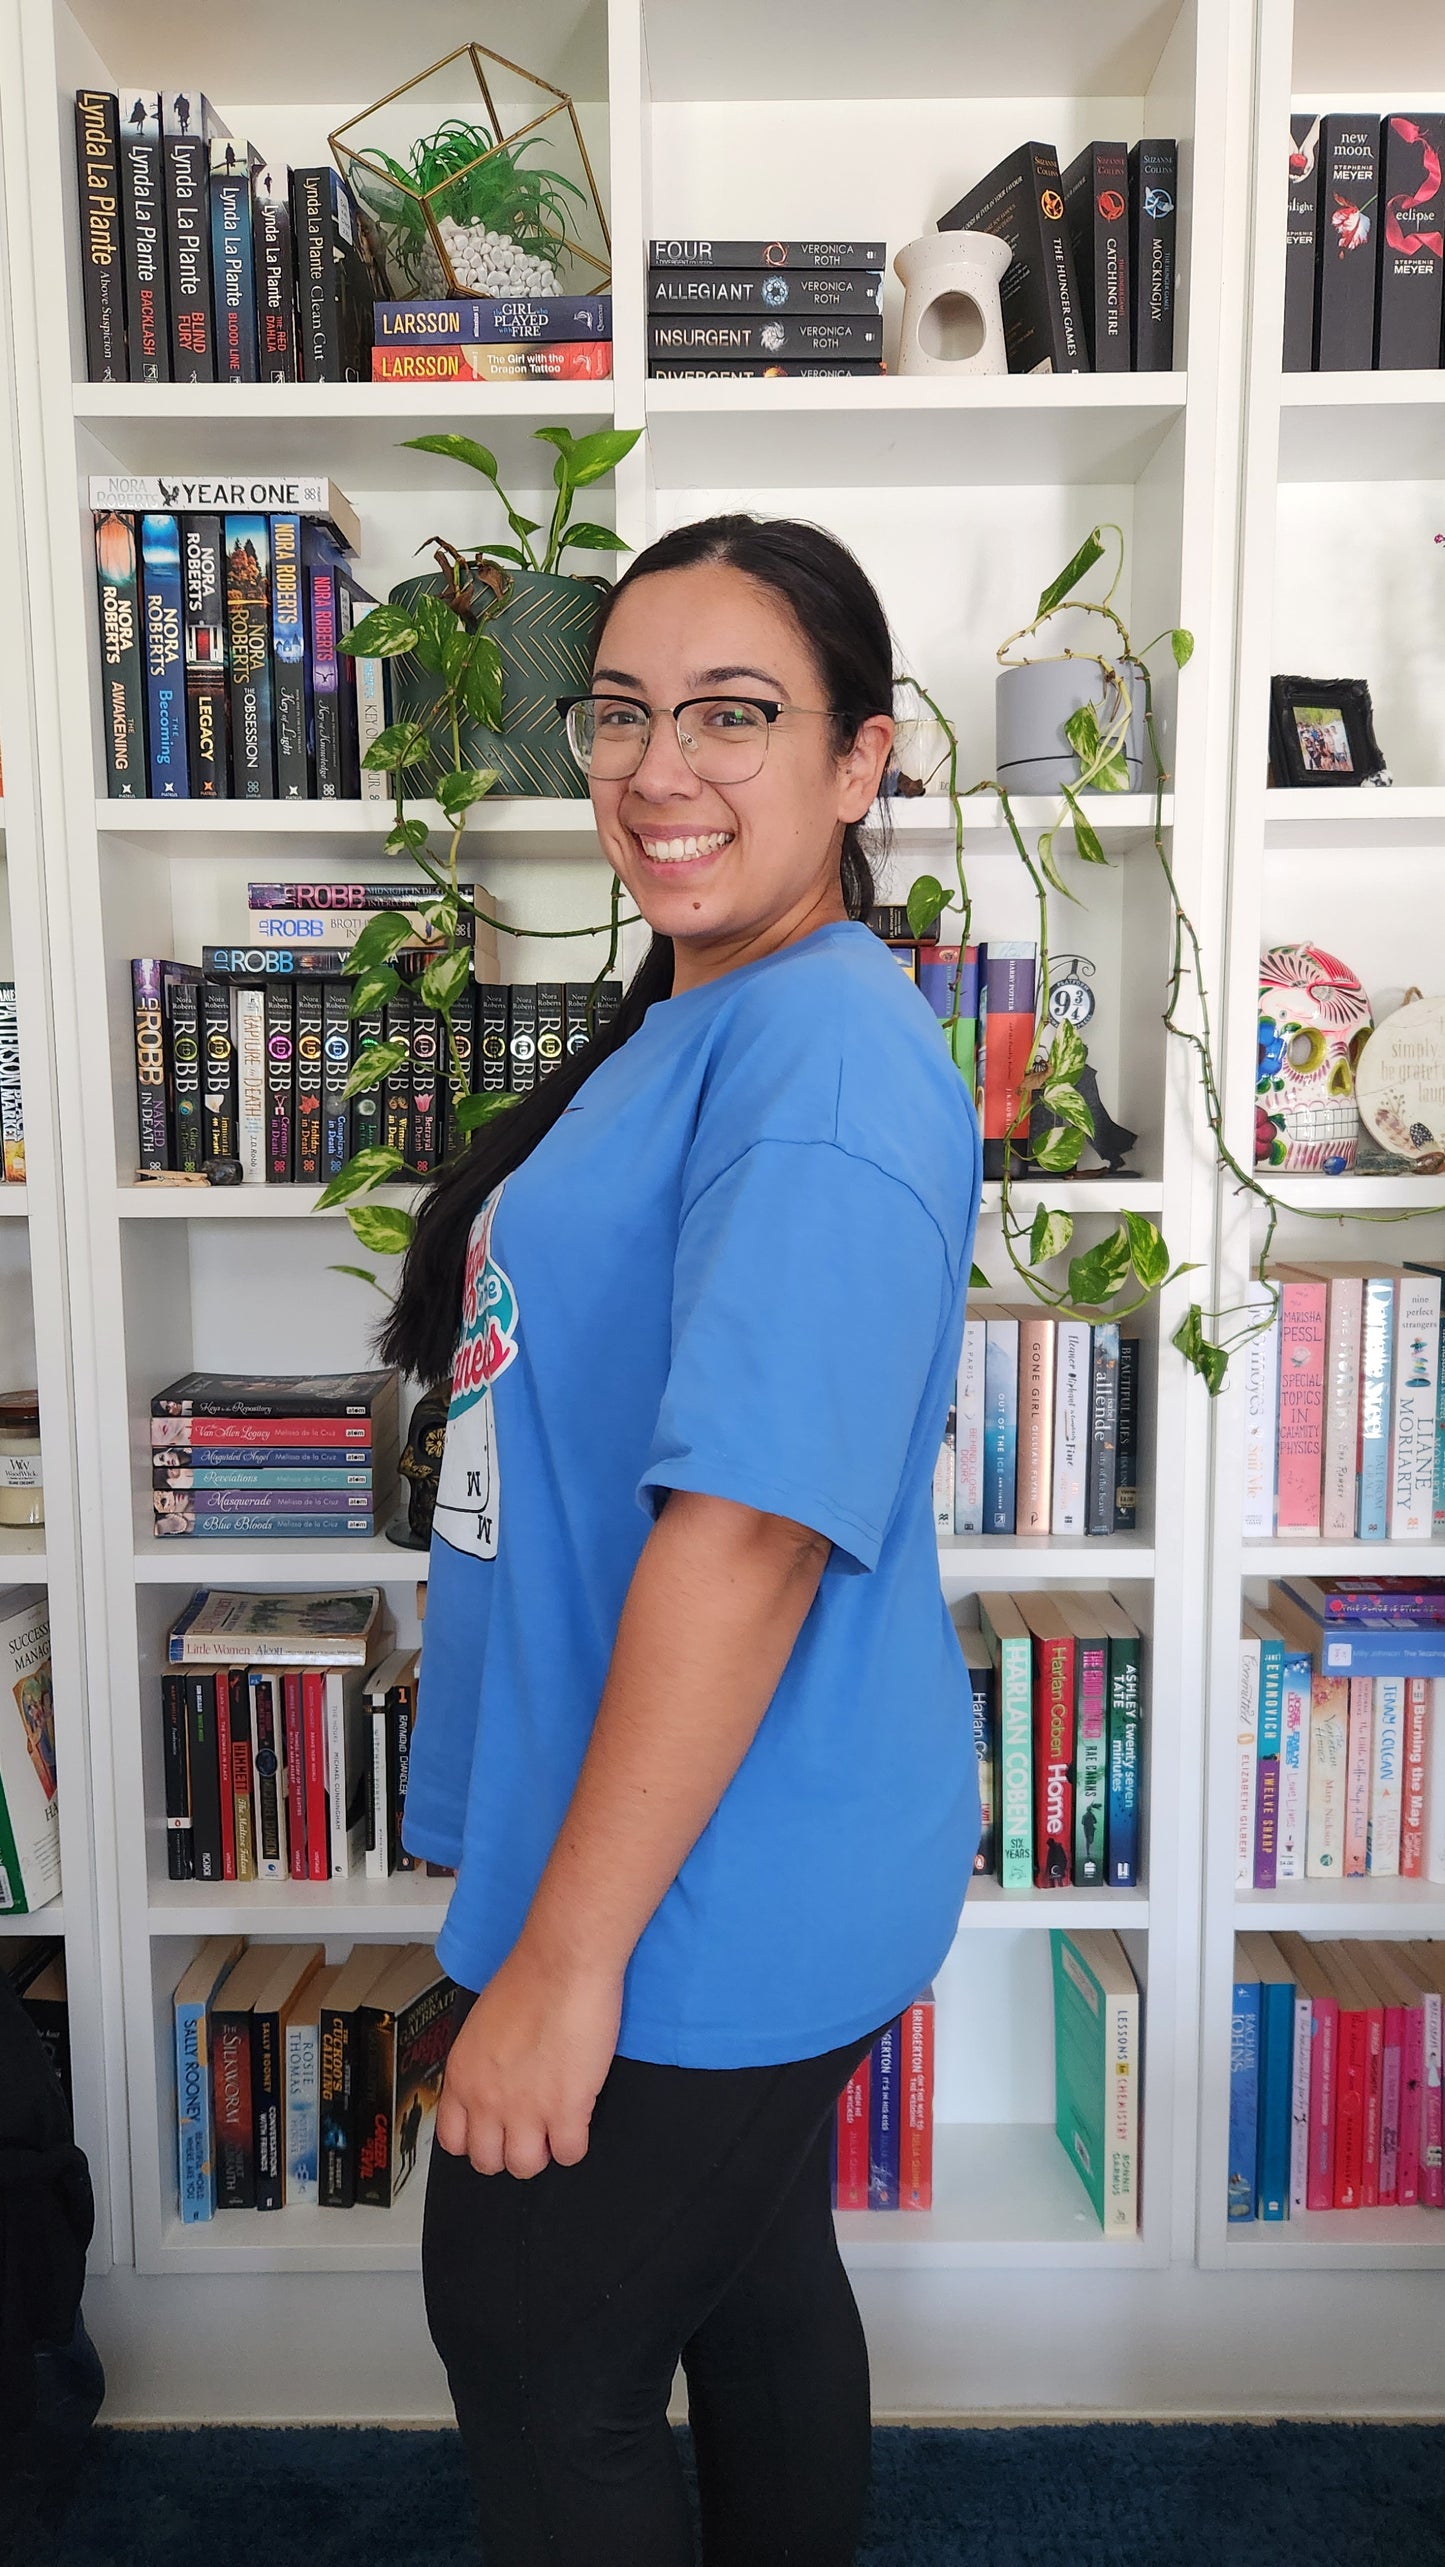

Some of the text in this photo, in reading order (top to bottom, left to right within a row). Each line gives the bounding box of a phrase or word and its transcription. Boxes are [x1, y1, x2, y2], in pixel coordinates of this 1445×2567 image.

[1334, 144, 1374, 159] moon
[1342, 133, 1368, 144] new
[79, 92, 117, 266] Lynda La Plante
[1333, 171, 1373, 180] MEYER
[128, 146, 156, 282] Lynda La Plante
[171, 145, 199, 296] Lynda La Plante
[303, 176, 323, 280] Lynda La Plante
[1396, 210, 1435, 231] eclipse
[220, 187, 243, 307] Lynda La Plante
[261, 206, 281, 309] Lynda La Plante
[655, 242, 712, 260] FOUR
[801, 245, 854, 255] VERONICA
[815, 255, 840, 265] ROTH
[801, 282, 853, 292] VERONICA
[1107, 238, 1118, 336] CATCHING FIRE
[1152, 238, 1162, 322] MOCKINGJAY
[1394, 265, 1433, 274] MEYER
[99, 271, 111, 358] Above Suspicion
[502, 304, 536, 316] GIRL
[655, 284, 753, 301] ALLEGIANT
[814, 294, 839, 304] ROTH
[1053, 238, 1077, 356] THE HUNGER GAMES
[140, 290, 155, 355] BACKLASH
[178, 315, 191, 350] FURY
[191, 312, 205, 353] BLIND
[228, 312, 240, 370] BLOOD LINE
[266, 316, 276, 352] DAHLIA
[276, 331, 286, 352] RED
[310, 285, 326, 360] Clean Cut
[383, 312, 460, 335] LARSSON
[494, 315, 549, 327] PLAYED
[512, 326, 541, 336] FIRE
[655, 330, 752, 347] INSURGENT
[800, 327, 852, 336] VERONICA
[488, 354, 564, 364] The Girl with the
[813, 339, 838, 348] ROTH
[382, 356, 459, 377] LARSSON
[491, 364, 560, 374] Dragon Tattoo
[183, 486, 299, 504] YEAR ONE
[186, 533, 202, 612] ROBERTS
[201, 548, 215, 598] NORA
[274, 523, 298, 625] NORA ROBERTS
[103, 586, 120, 665] ROBERTS
[117, 599, 133, 651] NORA
[148, 595, 165, 676] ROBERTS
[163, 608, 178, 664] NORA
[314, 577, 333, 661] NORA ROBERTS
[230, 609, 249, 685] ROBERTS
[249, 624, 265, 671] NORA
[111, 681, 129, 771] AWAKENING
[157, 690, 173, 765] Becoming
[199, 696, 214, 762] LEGACY
[244, 695, 259, 769] OBSESSION
[297, 886, 365, 908] ROBB
[270, 920, 324, 936] ROBB
[230, 951, 294, 973] ROBB
[1054, 990, 1070, 1016] 9
[136, 1011, 163, 1085] ROBB
[1392, 1038, 1439, 1062] simply
[142, 1092, 154, 1153] IN DEATH
[153, 1101, 164, 1148] NAKED
[1283, 1311, 1322, 1322] MARISHA
[1406, 1308, 1434, 1318] perfect
[1412, 1295, 1429, 1304] nine
[1283, 1326, 1322, 1342] PESSL
[1402, 1320, 1438, 1329] strangers
[1031, 1342, 1041, 1418] GONE GIRL
[1282, 1374, 1322, 1388] SPECIAL
[1282, 1391, 1321, 1406] TOPICS
[998, 1418, 1004, 1431] OF
[1094, 1371, 1112, 1441] allende
[1291, 1408, 1308, 1424] IN
[1279, 1441, 1320, 1455] PHYSICS
[1280, 1425, 1319, 1439] CALAMITY
[1416, 1417, 1434, 1490] LIANE
[1397, 1399, 1414, 1510] MORIARTY
[203, 1516, 273, 1531] Blue Bloods
[208, 1491, 272, 1512] Masquerade
[187, 1644, 250, 1656] Little Women
[1050, 1647, 1067, 1758] Harlan Coben
[1113, 1674, 1125, 1708] TATE
[1125, 1664, 1137, 1717] ASHLEY
[1264, 1665, 1279, 1739] EVANOVICH
[973, 1692, 986, 1739] Harlan
[1005, 1647, 1028, 1836] HARLAN COBEN
[1085, 1746, 1097, 1765] RAE
[233, 1742, 248, 1793] HAMMETT
[1085, 1767, 1097, 1797] CAIRNS
[1112, 1740, 1122, 1792] minutes
[1125, 1723, 1137, 1808] twenty seven
[1411, 1704, 1426, 1827] Burning the Map
[1046, 1764, 1067, 1834] Home
[1261, 1771, 1275, 1853] TWELVE SHARP
[1005, 1848, 1030, 1858] YEARS
[1011, 1838, 1023, 1848] SIX
[912, 2009, 924, 2074] BRIDGERTON
[1117, 2010, 1128, 2060] LESSONS
[1231, 2014, 1246, 2072] JOHNS
[184, 2020, 200, 2123] SALLY ROONEY
[222, 2033, 242, 2124] SILKWORM
[290, 2032, 300, 2095] THOMAS
[302, 2042, 314, 2084] ROSIE
